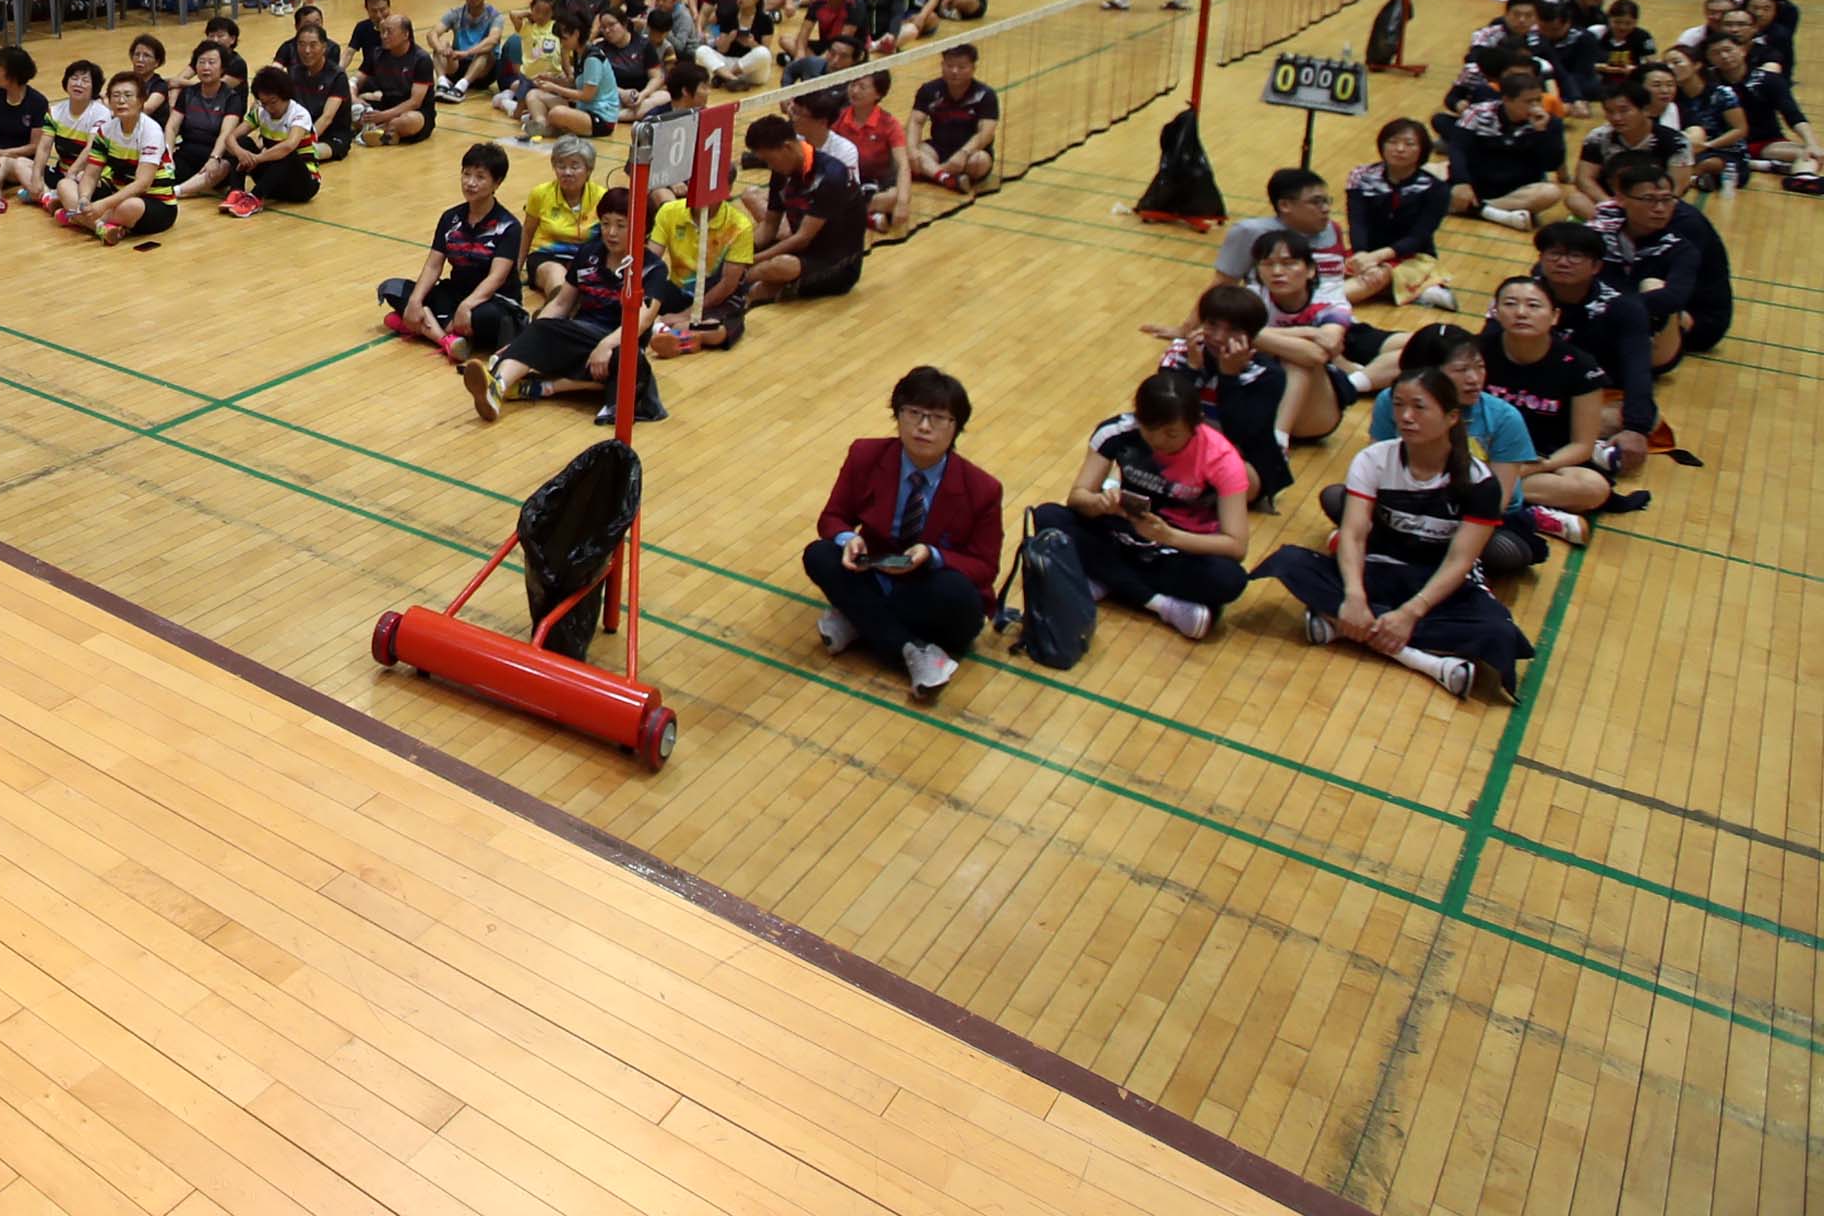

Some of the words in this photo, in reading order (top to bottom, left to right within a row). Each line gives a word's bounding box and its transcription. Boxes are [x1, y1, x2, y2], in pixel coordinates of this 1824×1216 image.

[1276, 63, 1296, 92] 0
[1335, 72, 1356, 101] 0
[703, 127, 722, 192] 1
